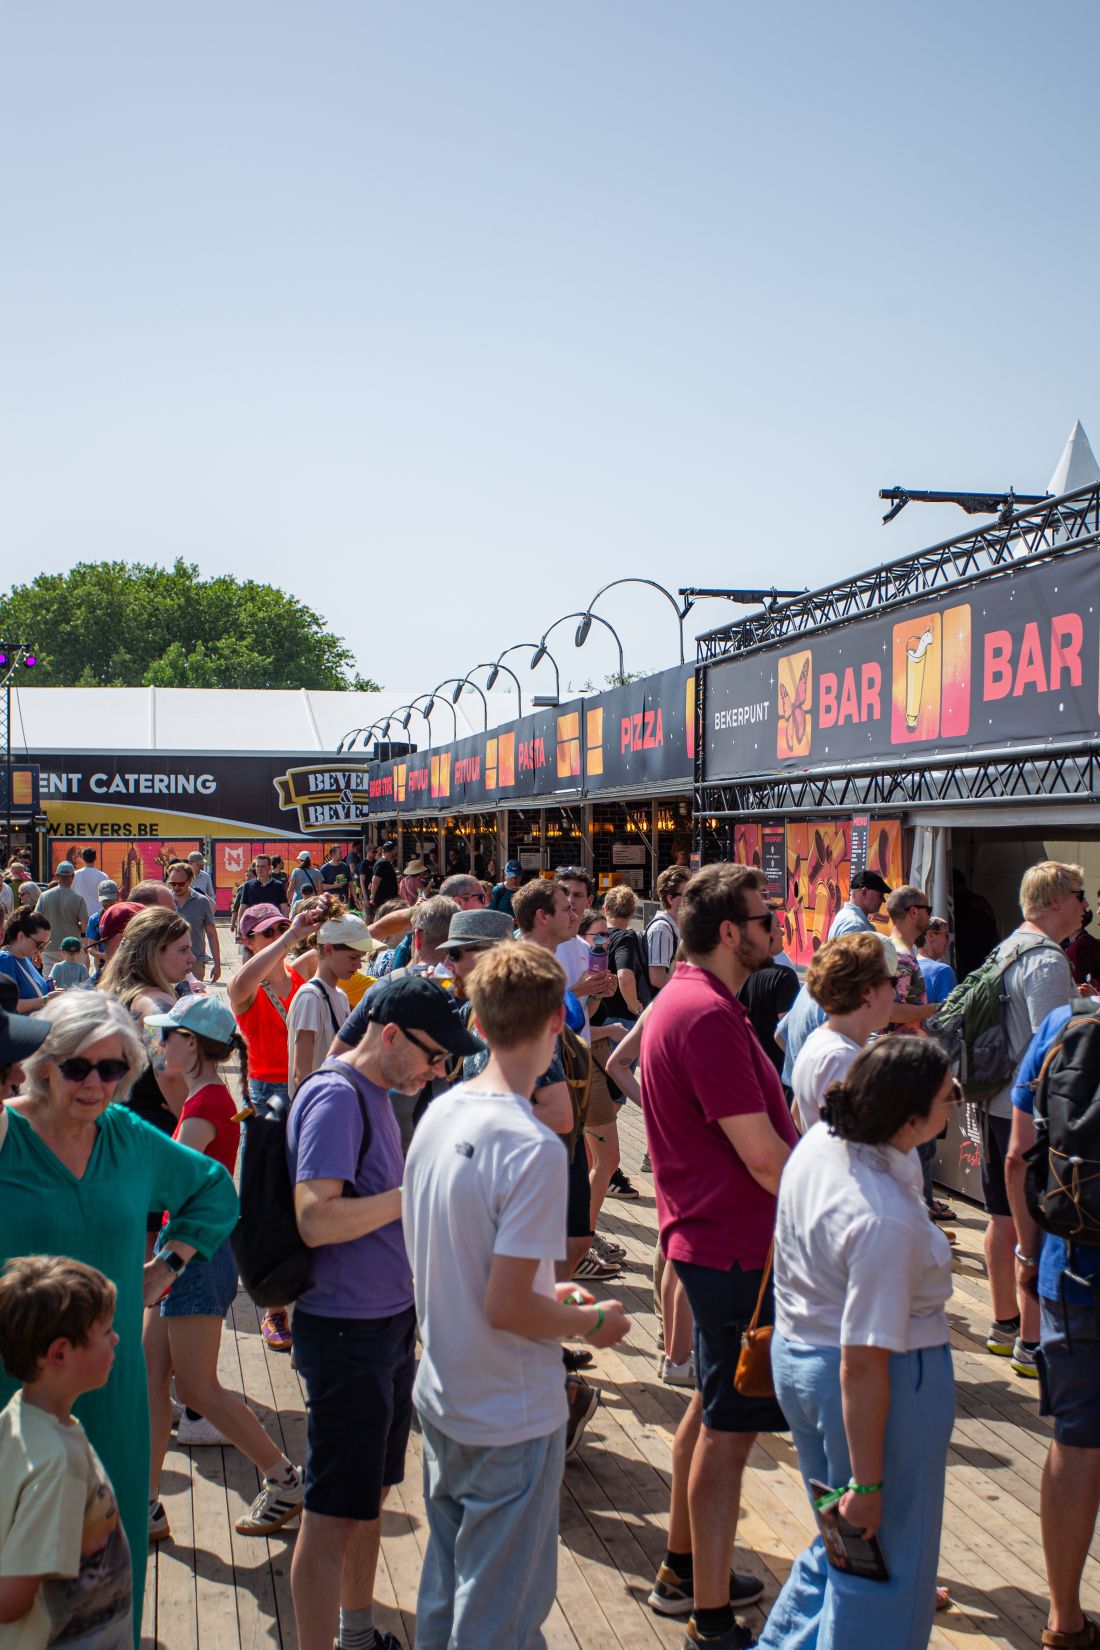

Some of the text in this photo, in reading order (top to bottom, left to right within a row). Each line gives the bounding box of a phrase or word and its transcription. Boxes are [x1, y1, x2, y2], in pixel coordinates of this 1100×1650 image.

[982, 612, 1084, 701] BAR
[818, 662, 882, 729] BAR
[620, 708, 664, 754] PIZZA
[714, 701, 770, 731] BEKERPUNT
[518, 737, 546, 772] PASTA
[89, 773, 217, 794] CATERING
[308, 804, 369, 823] BEVE
